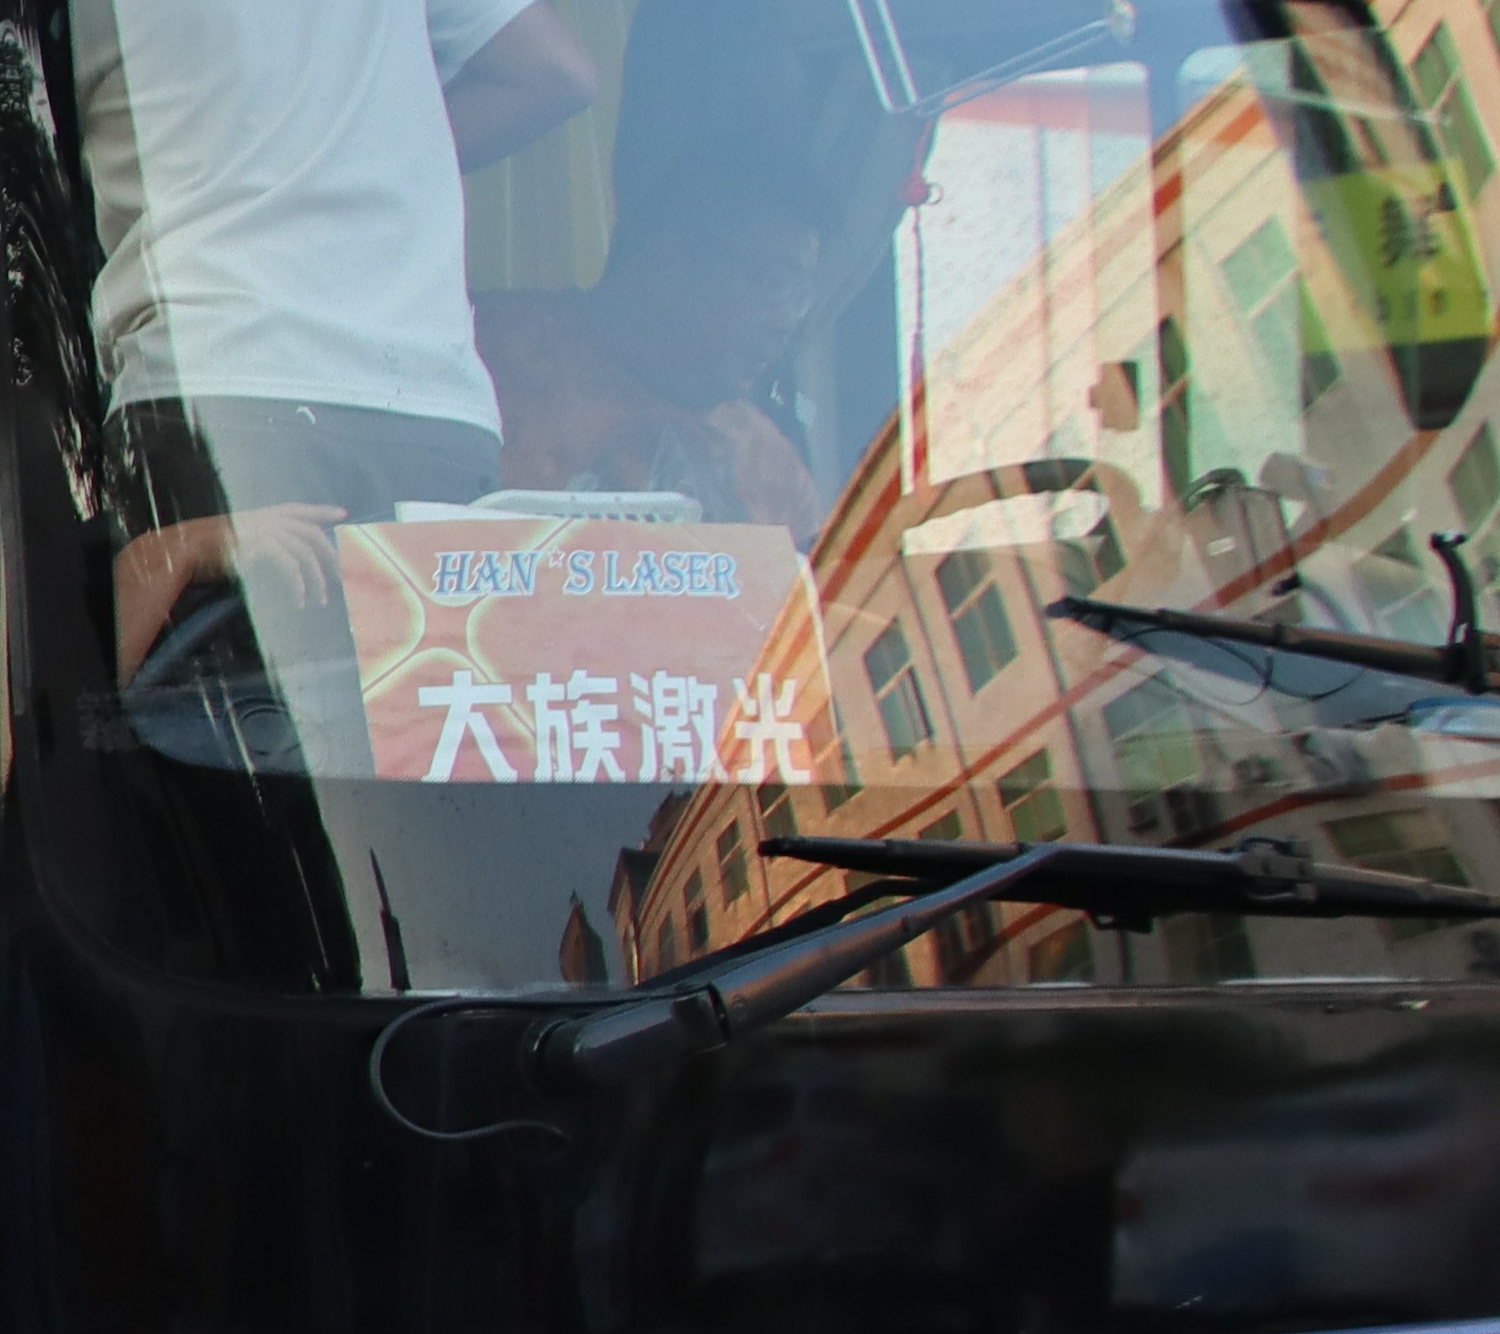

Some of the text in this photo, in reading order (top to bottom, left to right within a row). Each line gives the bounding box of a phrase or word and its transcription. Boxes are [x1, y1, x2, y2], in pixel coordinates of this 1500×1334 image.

[605, 551, 740, 600] LASER
[418, 668, 812, 783] 大族激光
